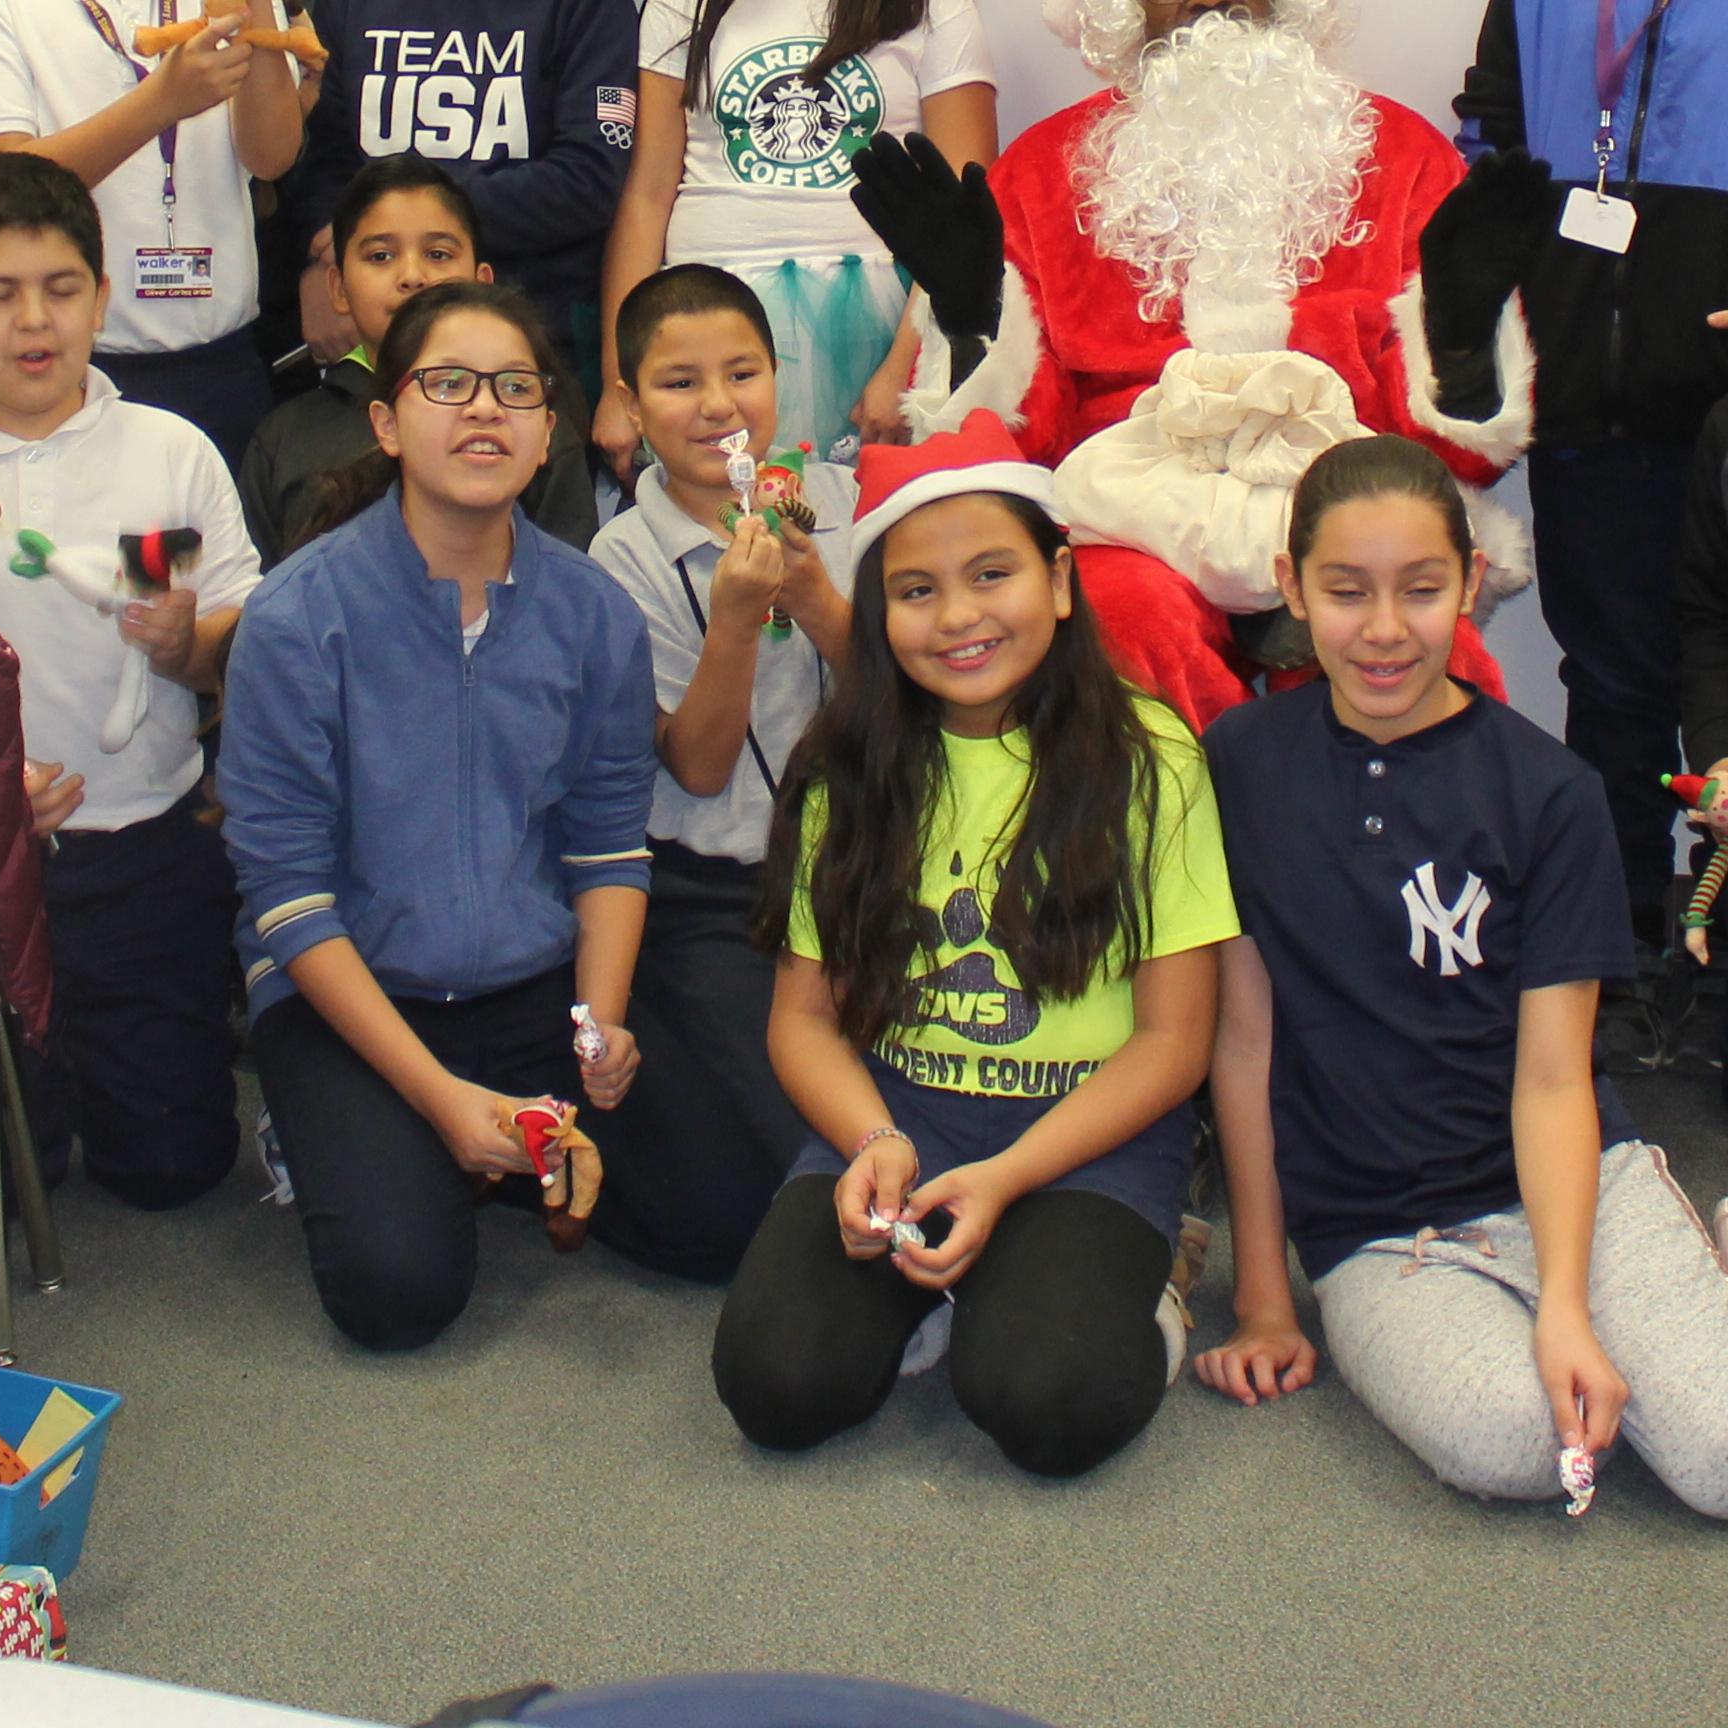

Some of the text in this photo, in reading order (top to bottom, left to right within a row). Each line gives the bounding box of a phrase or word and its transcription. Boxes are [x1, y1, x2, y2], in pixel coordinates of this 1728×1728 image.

[365, 30, 524, 74] TEAM
[720, 38, 875, 114] STARBCKS
[360, 75, 530, 160] USA
[138, 257, 185, 268] walker
